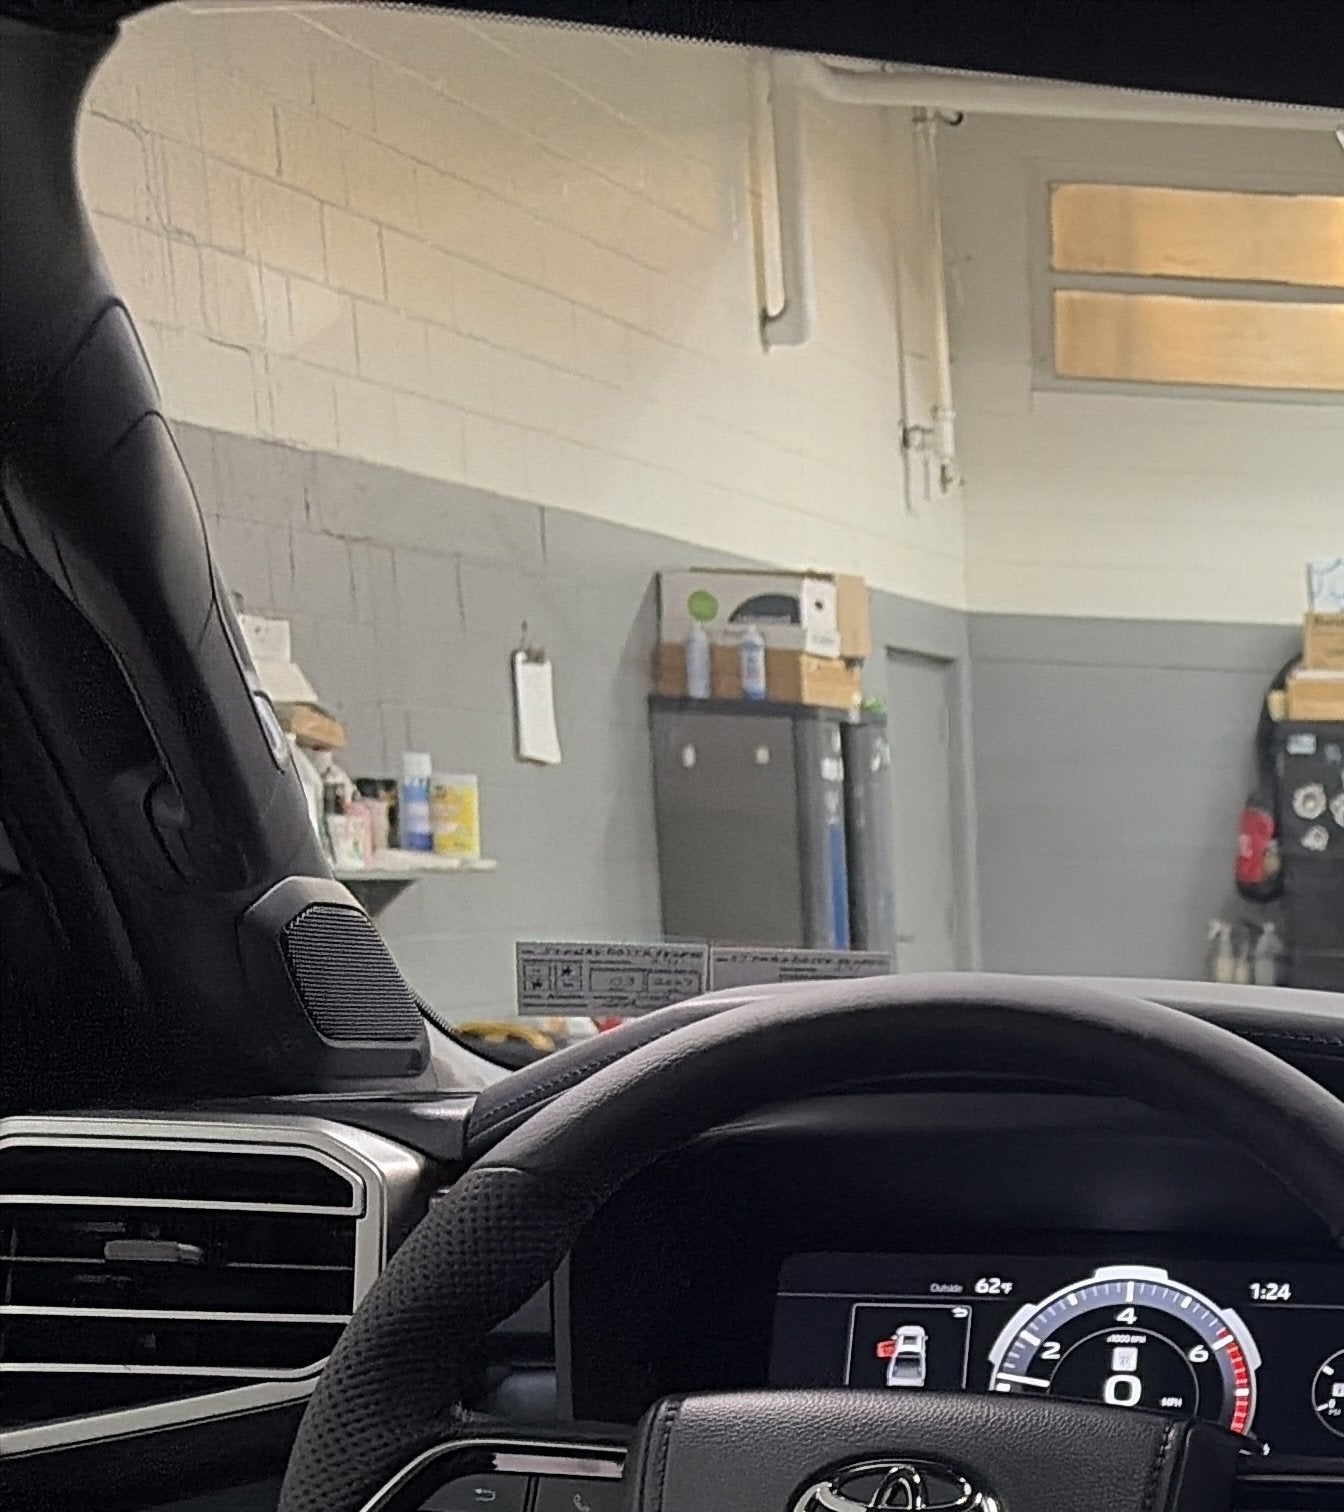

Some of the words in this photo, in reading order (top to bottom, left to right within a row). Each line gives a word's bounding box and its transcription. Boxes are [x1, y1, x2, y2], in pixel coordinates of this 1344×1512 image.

[1250, 1283, 1292, 1301] 1:24
[1115, 1307, 1137, 1325] 4
[1041, 1342, 1061, 1360] 2
[1189, 1345, 1209, 1363] 6
[1103, 1374, 1142, 1407] 0
